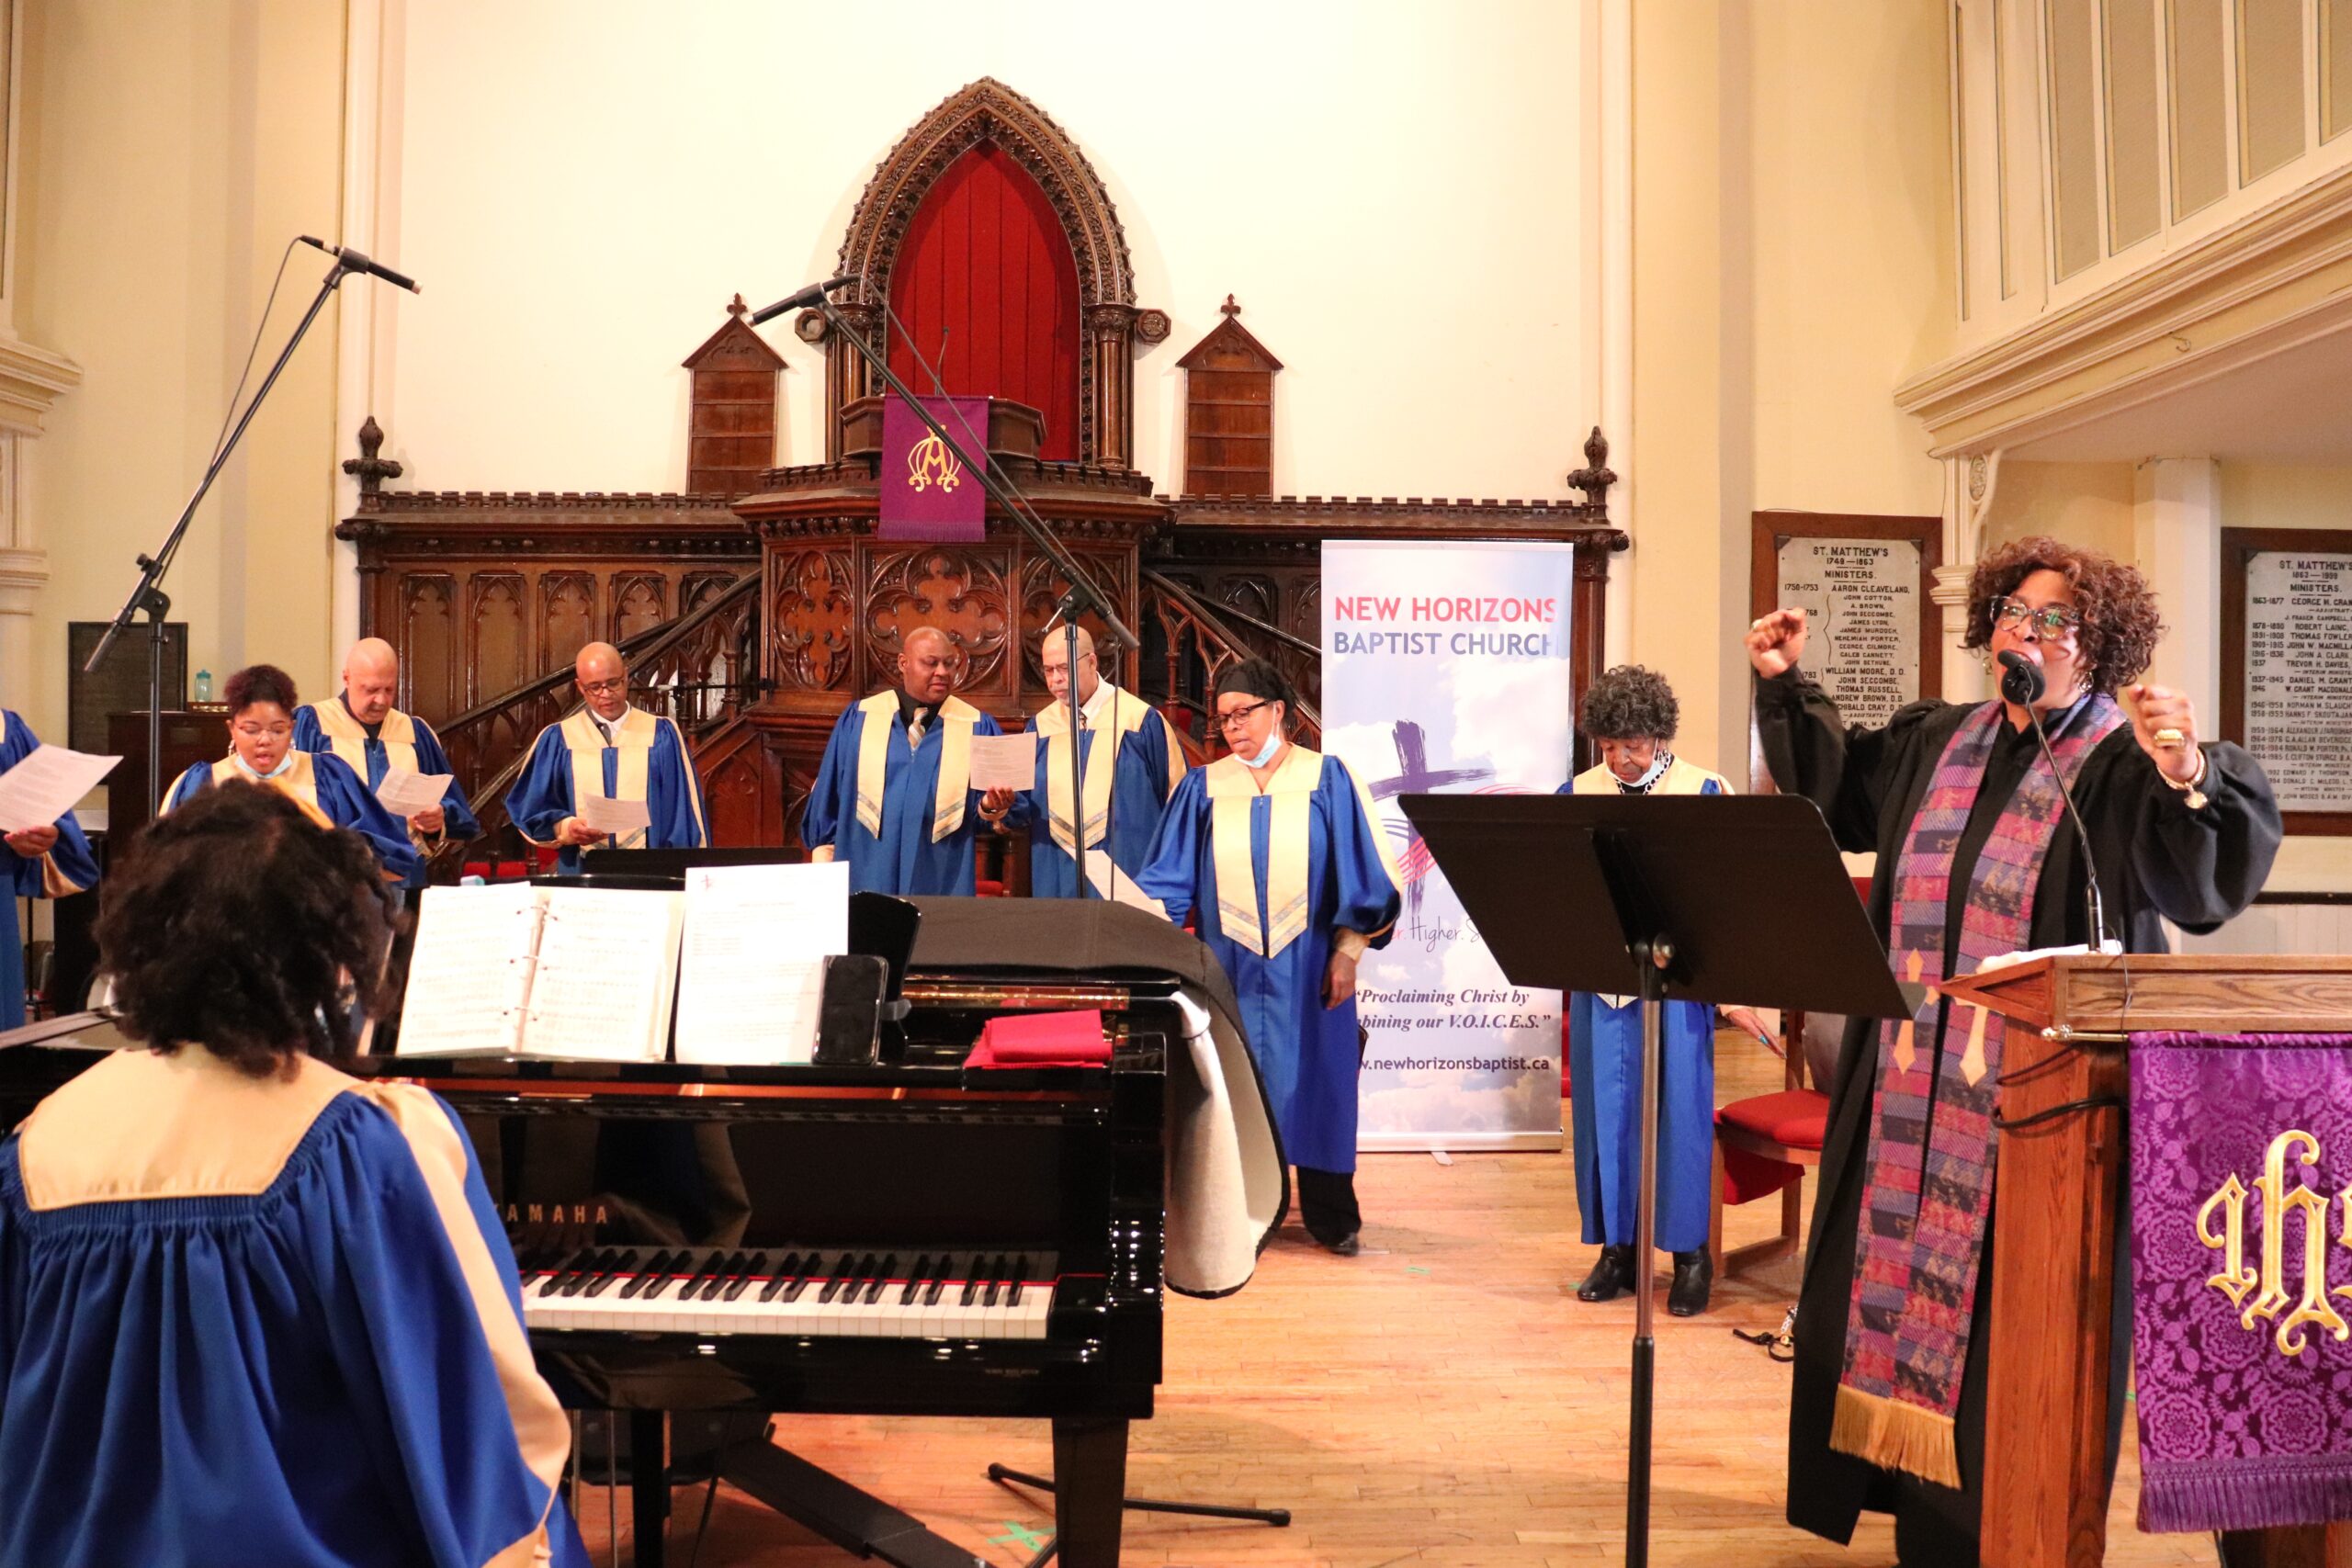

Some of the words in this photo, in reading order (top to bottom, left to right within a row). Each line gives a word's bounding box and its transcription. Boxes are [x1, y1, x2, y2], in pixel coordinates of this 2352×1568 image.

[1813, 547, 1828, 556] ST.
[1830, 547, 1889, 557] MATTHEW'S
[2279, 560, 2293, 570] ST.
[2298, 560, 2352, 570] MATTHEW'S
[1825, 570, 1877, 579] MINISTERS.
[2290, 584, 2342, 592] MINISTERS.
[1335, 597, 1401, 622] NEW
[1412, 597, 1558, 623] HORIZONS
[1334, 632, 1442, 654] BAPTIST
[1450, 633, 1559, 656] CHURCH
[1409, 916, 1464, 953] Higher.
[1461, 989, 1508, 1003] Christ
[1511, 989, 1530, 1006] by
[1357, 1015, 1412, 1032] bining
[1416, 1018, 1443, 1029] our
[1360, 1057, 1550, 1073] w.newhorizonsbaptist.ca
[495, 1204, 608, 1224] AMAHA
